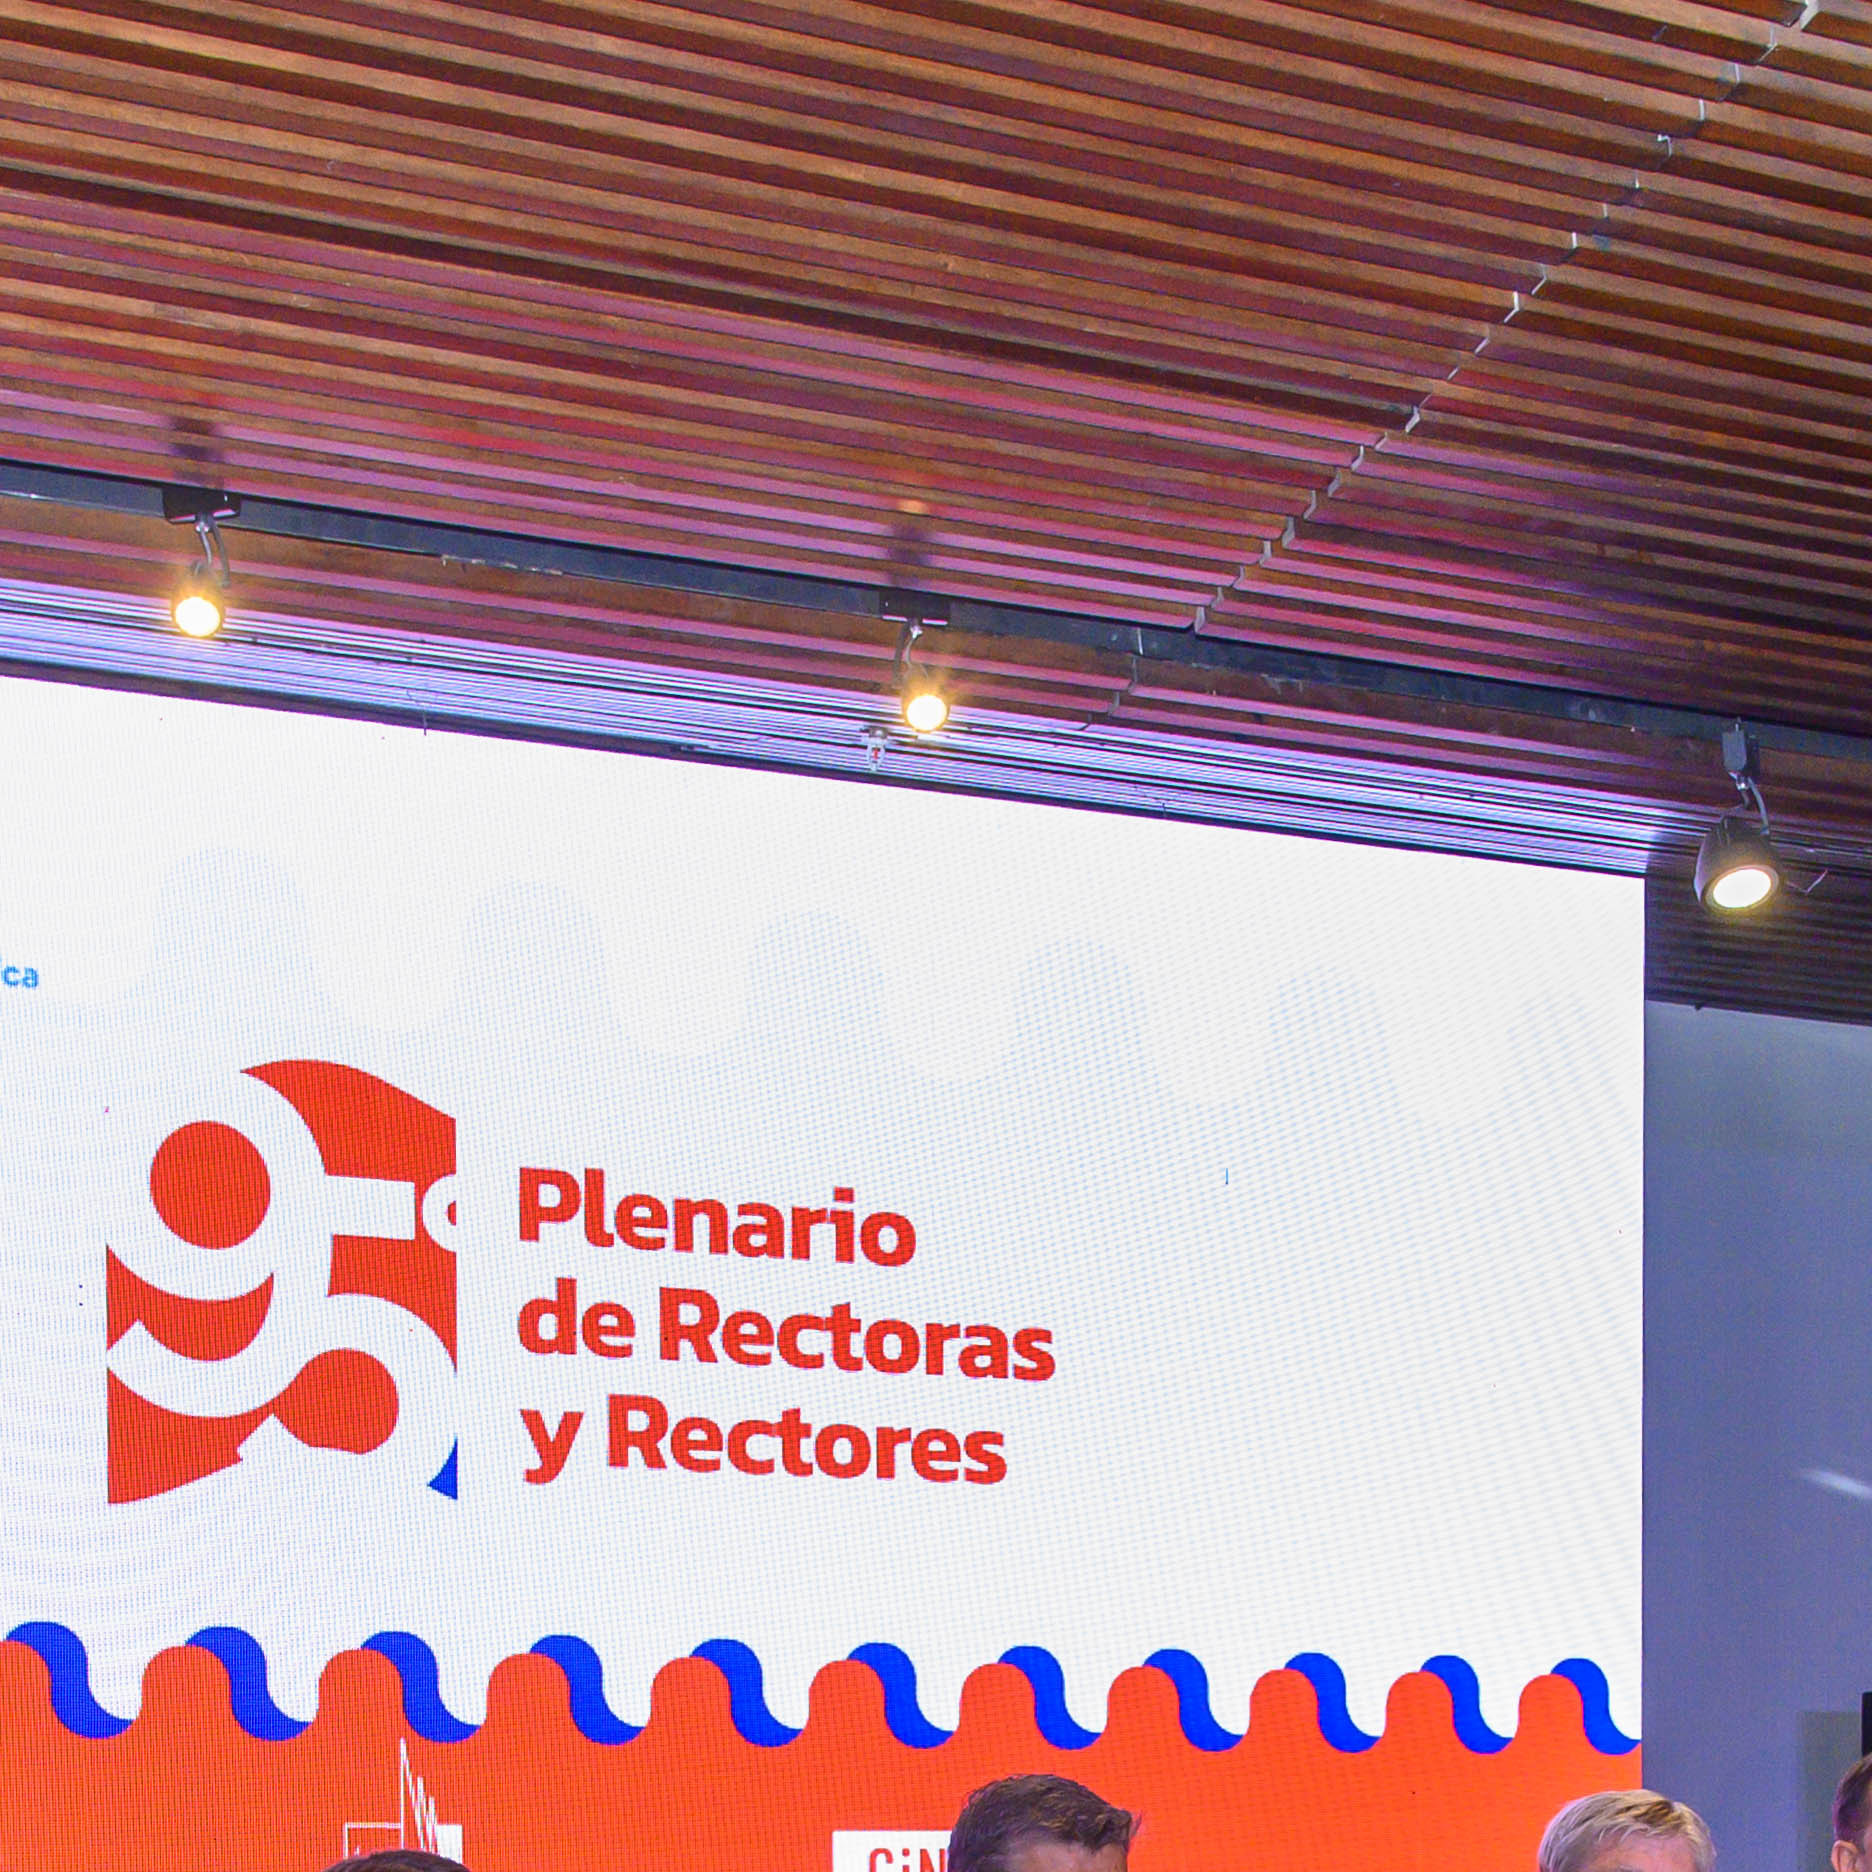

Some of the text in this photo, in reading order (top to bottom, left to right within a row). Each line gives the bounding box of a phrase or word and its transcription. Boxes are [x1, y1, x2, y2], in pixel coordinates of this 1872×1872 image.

[519, 1166, 916, 1267] Plenario
[517, 1277, 1056, 1381] de Rectoras
[519, 1393, 1008, 1486] y Rectores
